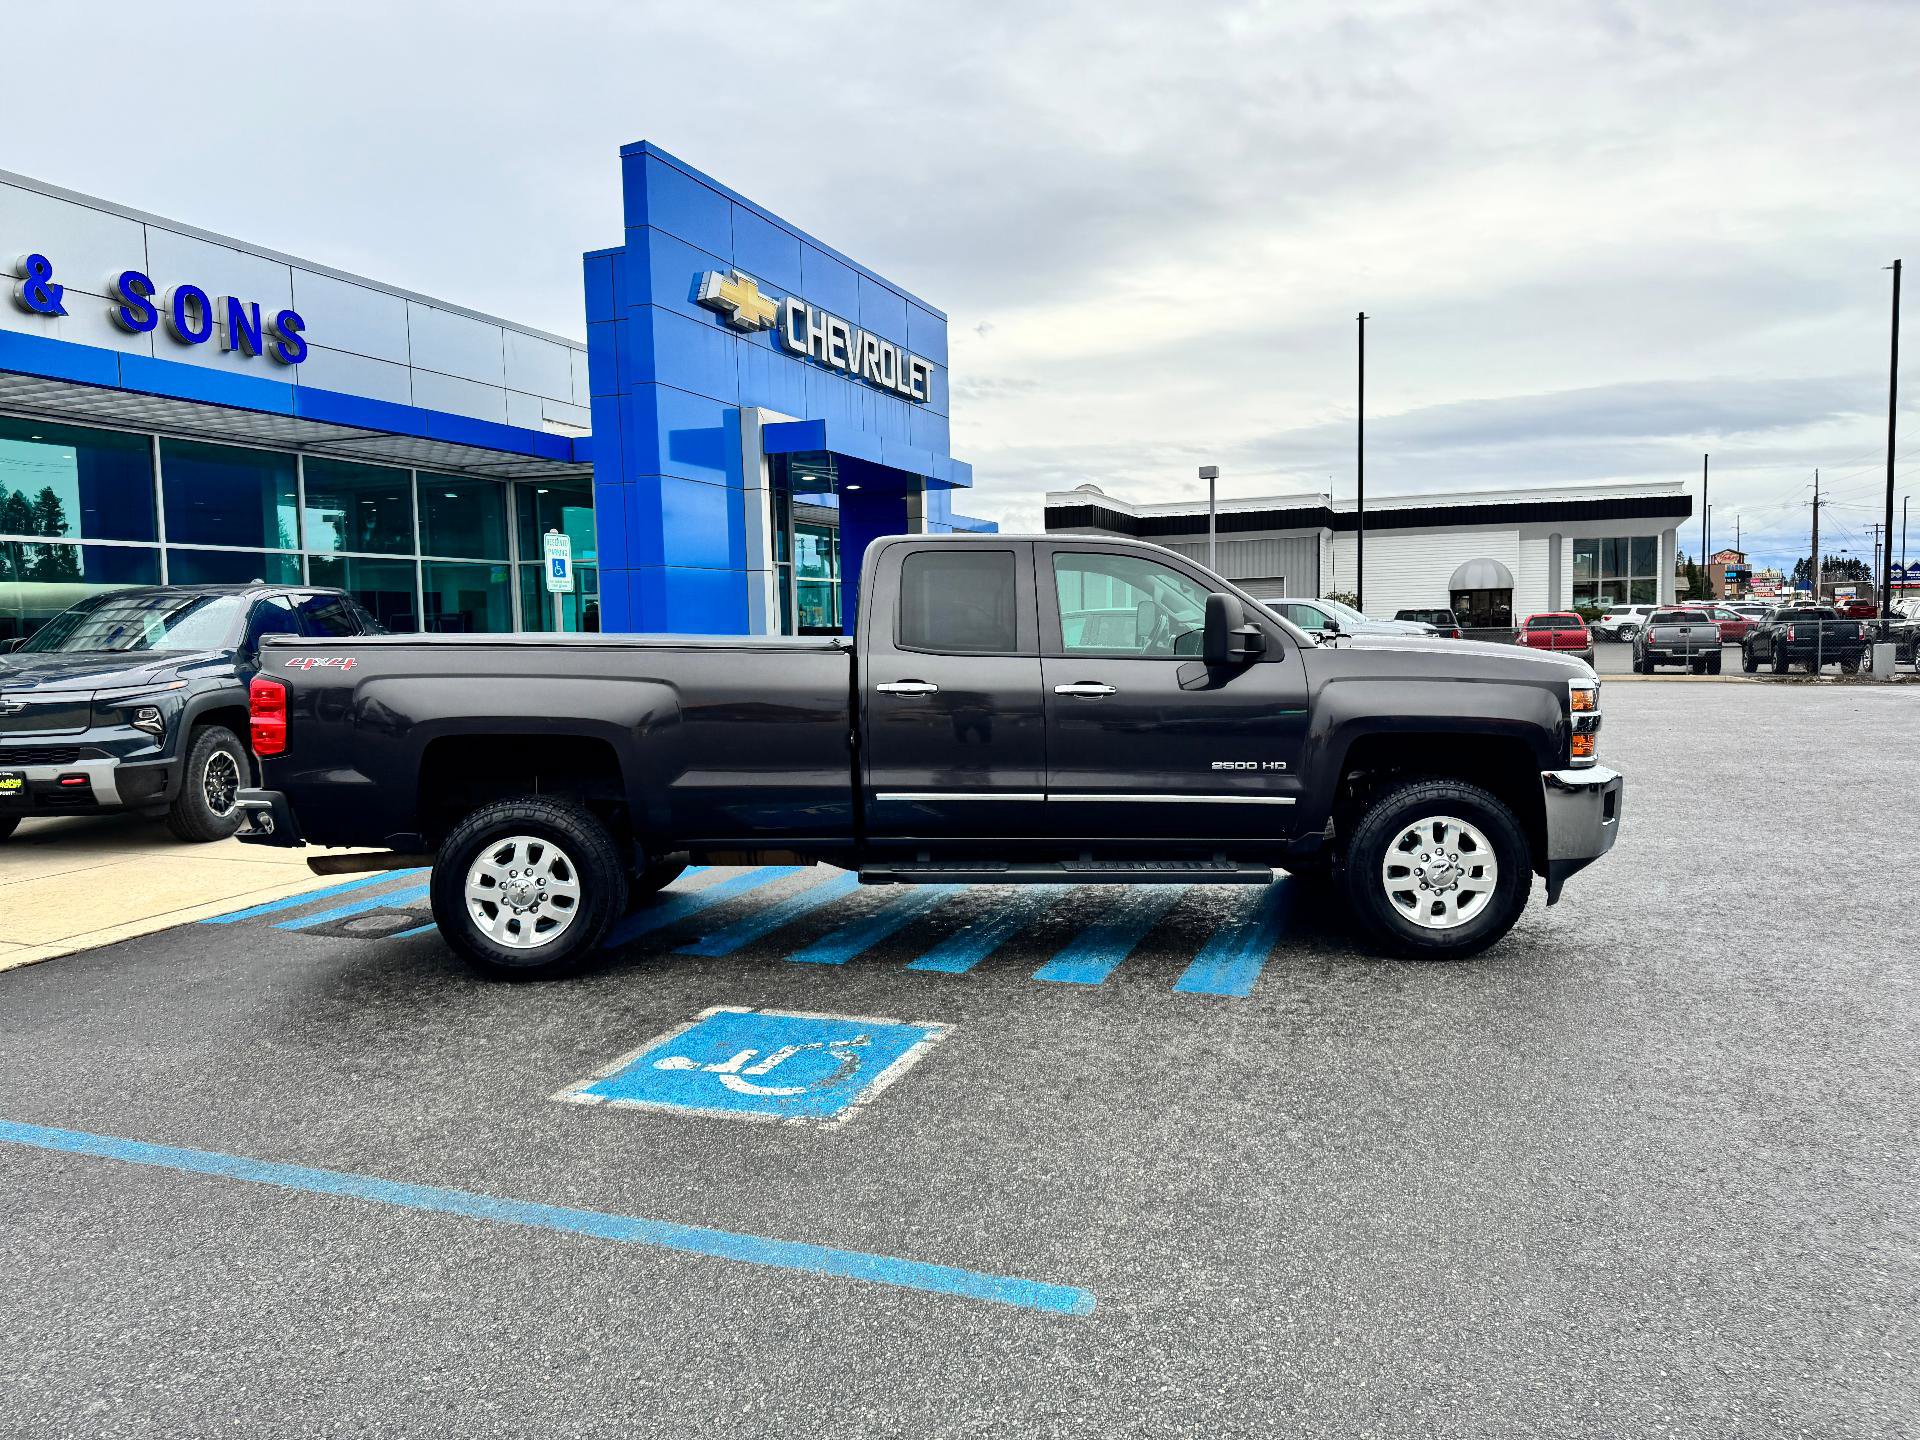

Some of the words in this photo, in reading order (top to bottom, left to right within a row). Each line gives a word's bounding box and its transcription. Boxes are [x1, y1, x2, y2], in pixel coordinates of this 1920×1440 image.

[15, 254, 69, 316] &
[109, 270, 308, 364] SONS
[785, 296, 934, 403] CHEVROLET
[1211, 761, 1258, 770] 2500
[1262, 761, 1287, 770] HD
